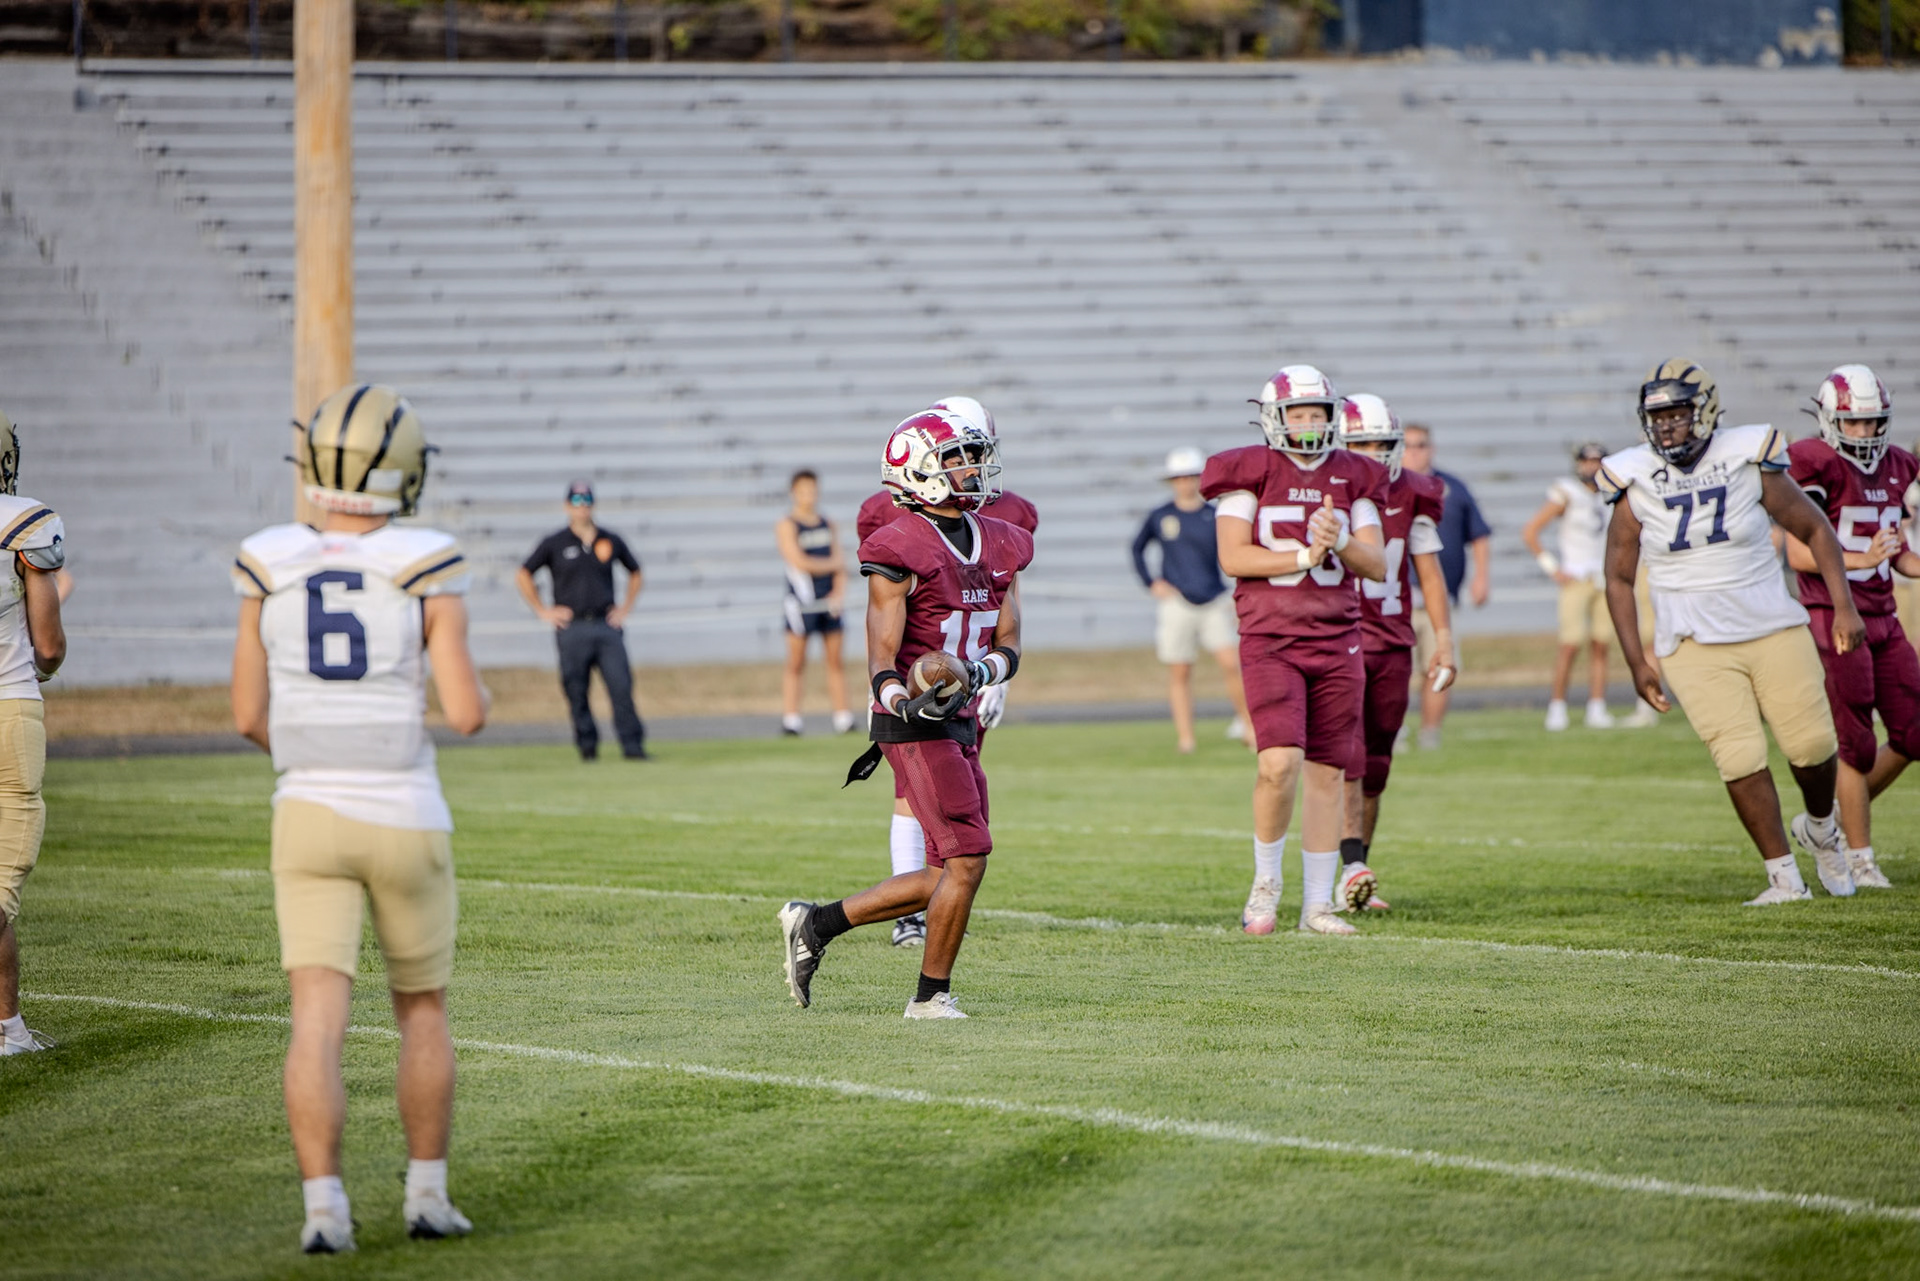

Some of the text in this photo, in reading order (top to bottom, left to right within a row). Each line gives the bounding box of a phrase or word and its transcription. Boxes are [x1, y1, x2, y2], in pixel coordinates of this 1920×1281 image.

[1287, 487, 1323, 503] RAMS
[1663, 484, 1730, 552] 77
[961, 588, 989, 604] RAMS
[1354, 538, 1406, 616] 4
[306, 569, 369, 682] 6
[939, 609, 1001, 663] 15
